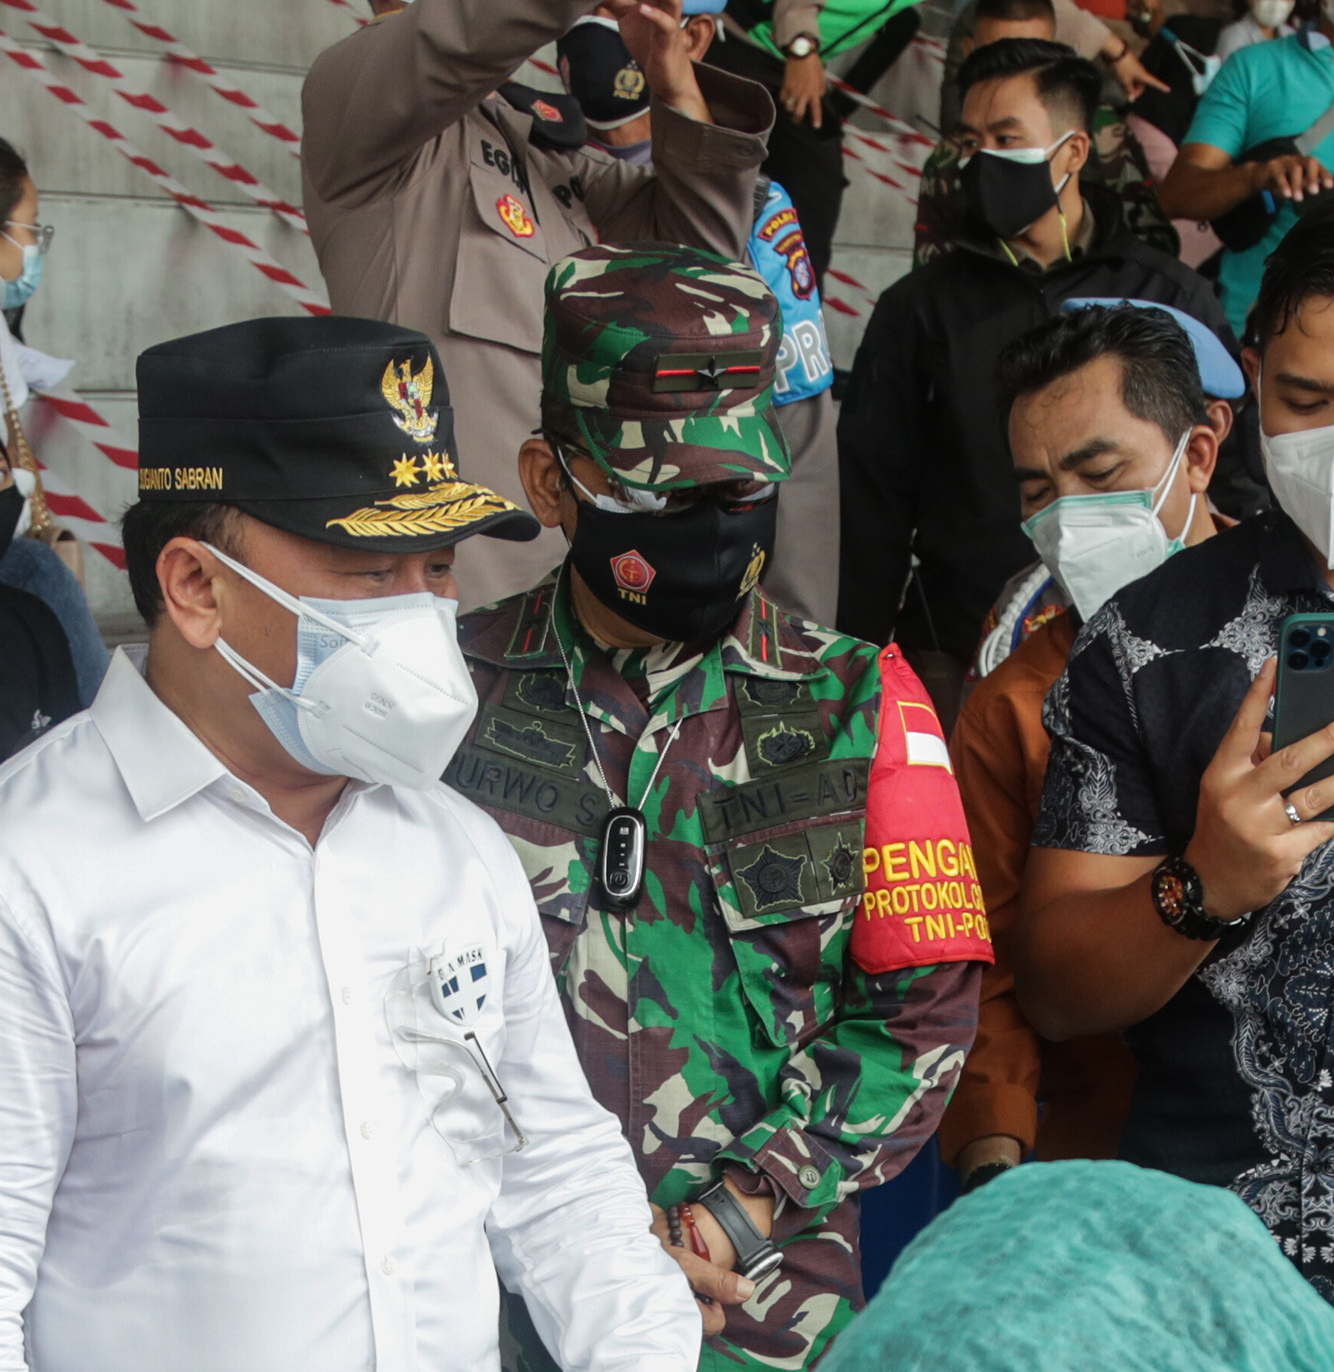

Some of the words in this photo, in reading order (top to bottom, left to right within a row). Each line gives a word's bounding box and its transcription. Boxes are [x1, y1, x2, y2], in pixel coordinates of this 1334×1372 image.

[174, 467, 223, 490] SABRAN
[618, 587, 647, 606] TNI
[453, 753, 560, 813] URWO
[575, 792, 600, 826] S
[862, 838, 978, 887] PENGA
[863, 881, 974, 921] PROTOKOL
